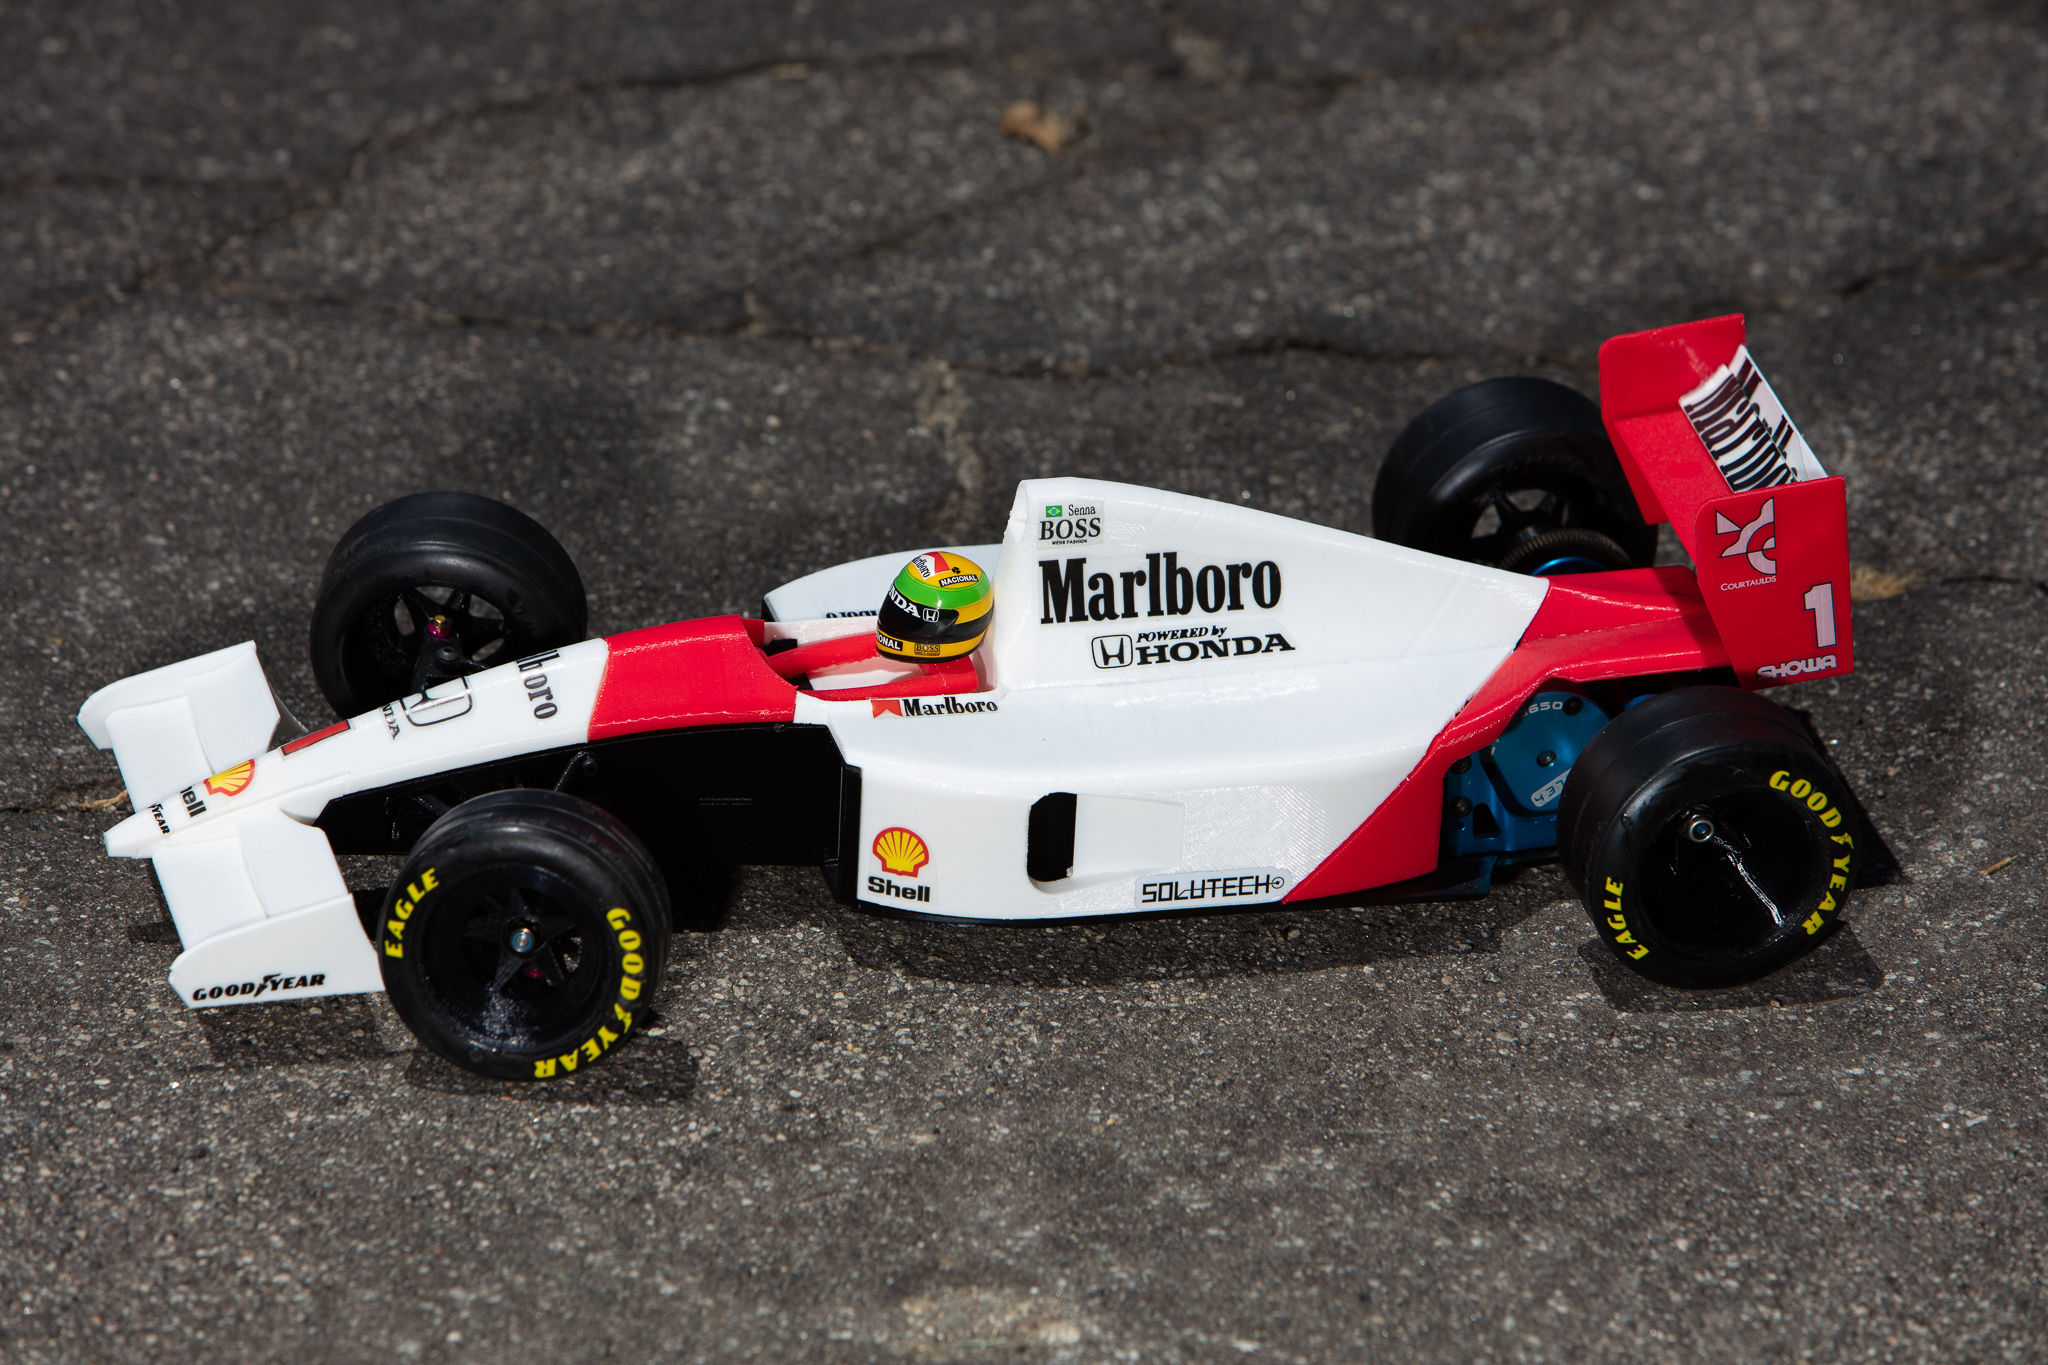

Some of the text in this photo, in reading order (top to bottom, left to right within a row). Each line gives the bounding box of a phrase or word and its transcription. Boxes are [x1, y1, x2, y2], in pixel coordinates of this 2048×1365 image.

[1068, 504, 1096, 516] Senna
[1039, 517, 1101, 540] BOSS
[940, 574, 977, 587] NACIONAL
[1039, 551, 1282, 624] Marlboro
[1720, 575, 1777, 591] COURTAULDS
[1803, 581, 1837, 648] 1
[1136, 625, 1227, 643] POWERED by
[1135, 633, 1296, 665] HONDA
[1756, 654, 1837, 681] SHOWA
[516, 649, 560, 719] lboro
[902, 696, 998, 717] Marlboro
[1523, 701, 1563, 716] 650
[868, 875, 930, 903] Shell
[1142, 874, 1271, 904] SOLUTECH
[384, 867, 440, 959] EAGLE
[1604, 876, 1650, 960] EAGLE
